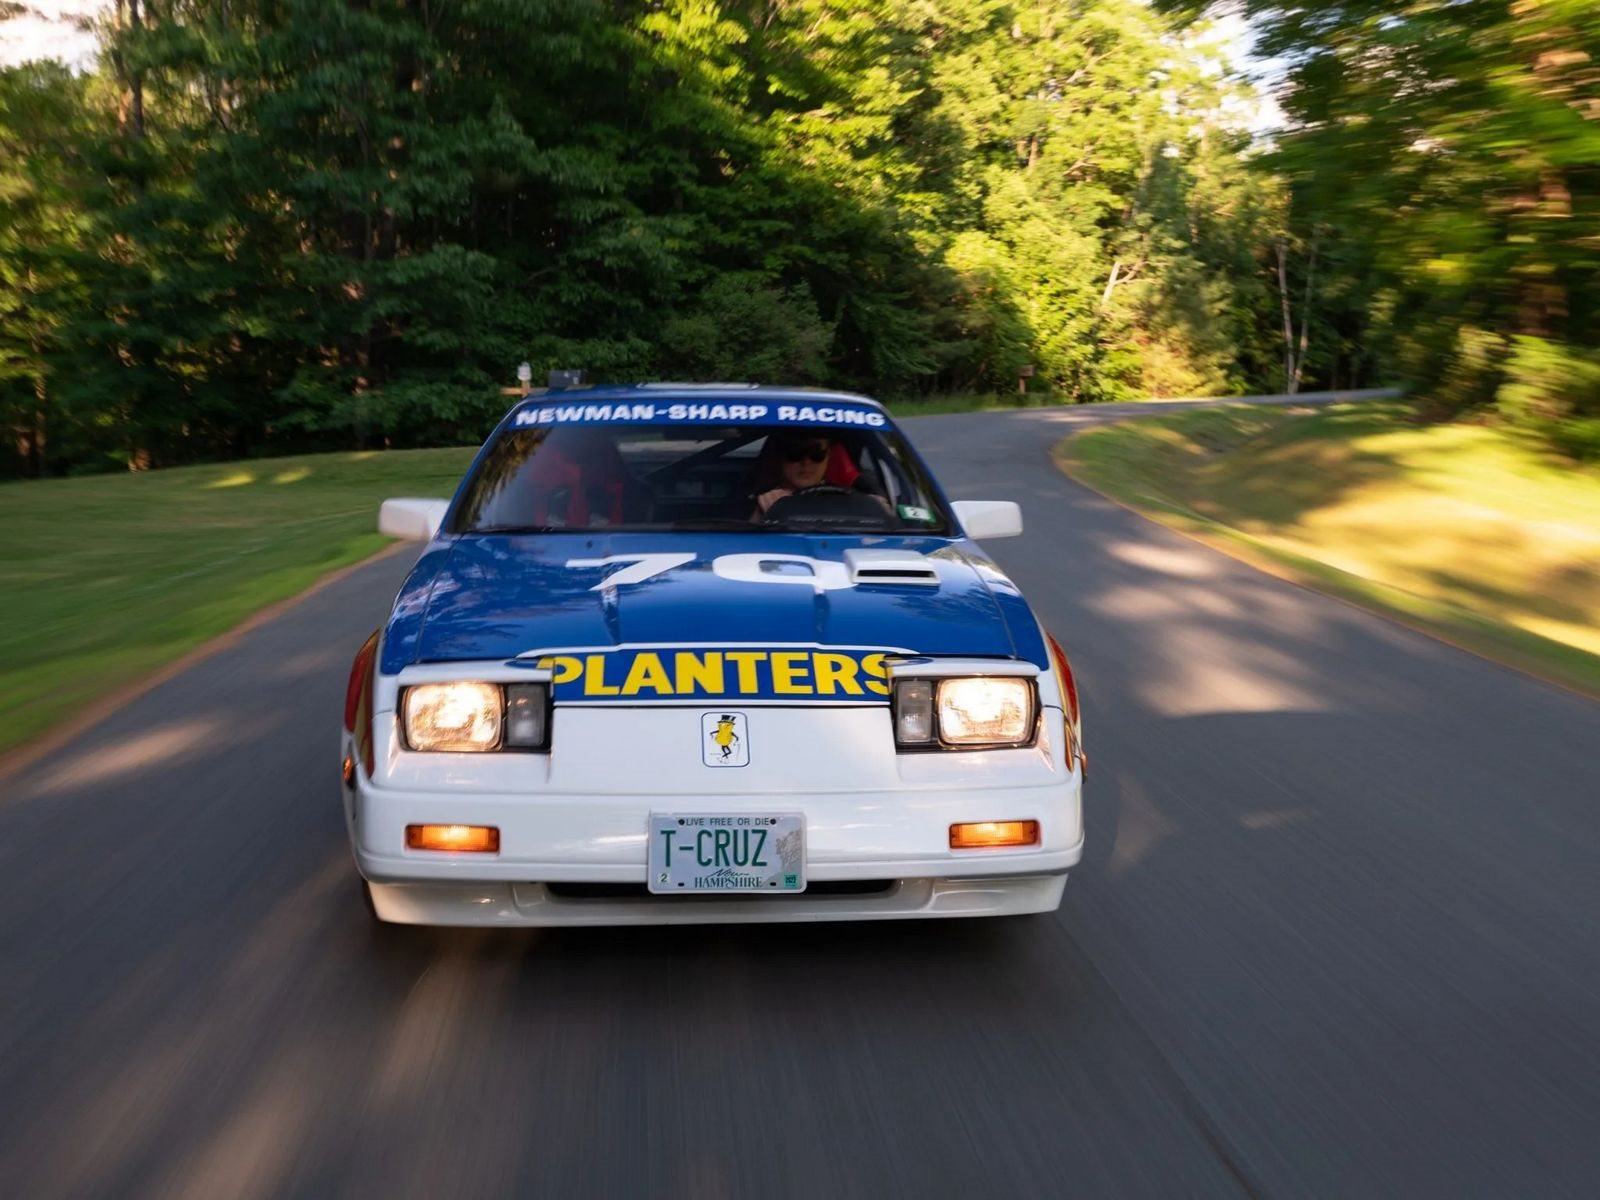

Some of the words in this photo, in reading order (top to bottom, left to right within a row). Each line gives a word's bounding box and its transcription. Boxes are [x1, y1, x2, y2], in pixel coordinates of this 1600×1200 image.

[515, 404, 768, 426] NEWMAN-SHARP
[777, 406, 886, 426] RACING
[536, 652, 894, 696] PLANTERS
[686, 817, 704, 826] LIVE
[710, 817, 732, 826] FREE
[737, 817, 750, 826] OR
[755, 817, 769, 826] DIE
[660, 829, 768, 867] T-CRUZ
[661, 873, 668, 883] 2
[694, 876, 762, 889] HAMPSHIRE
